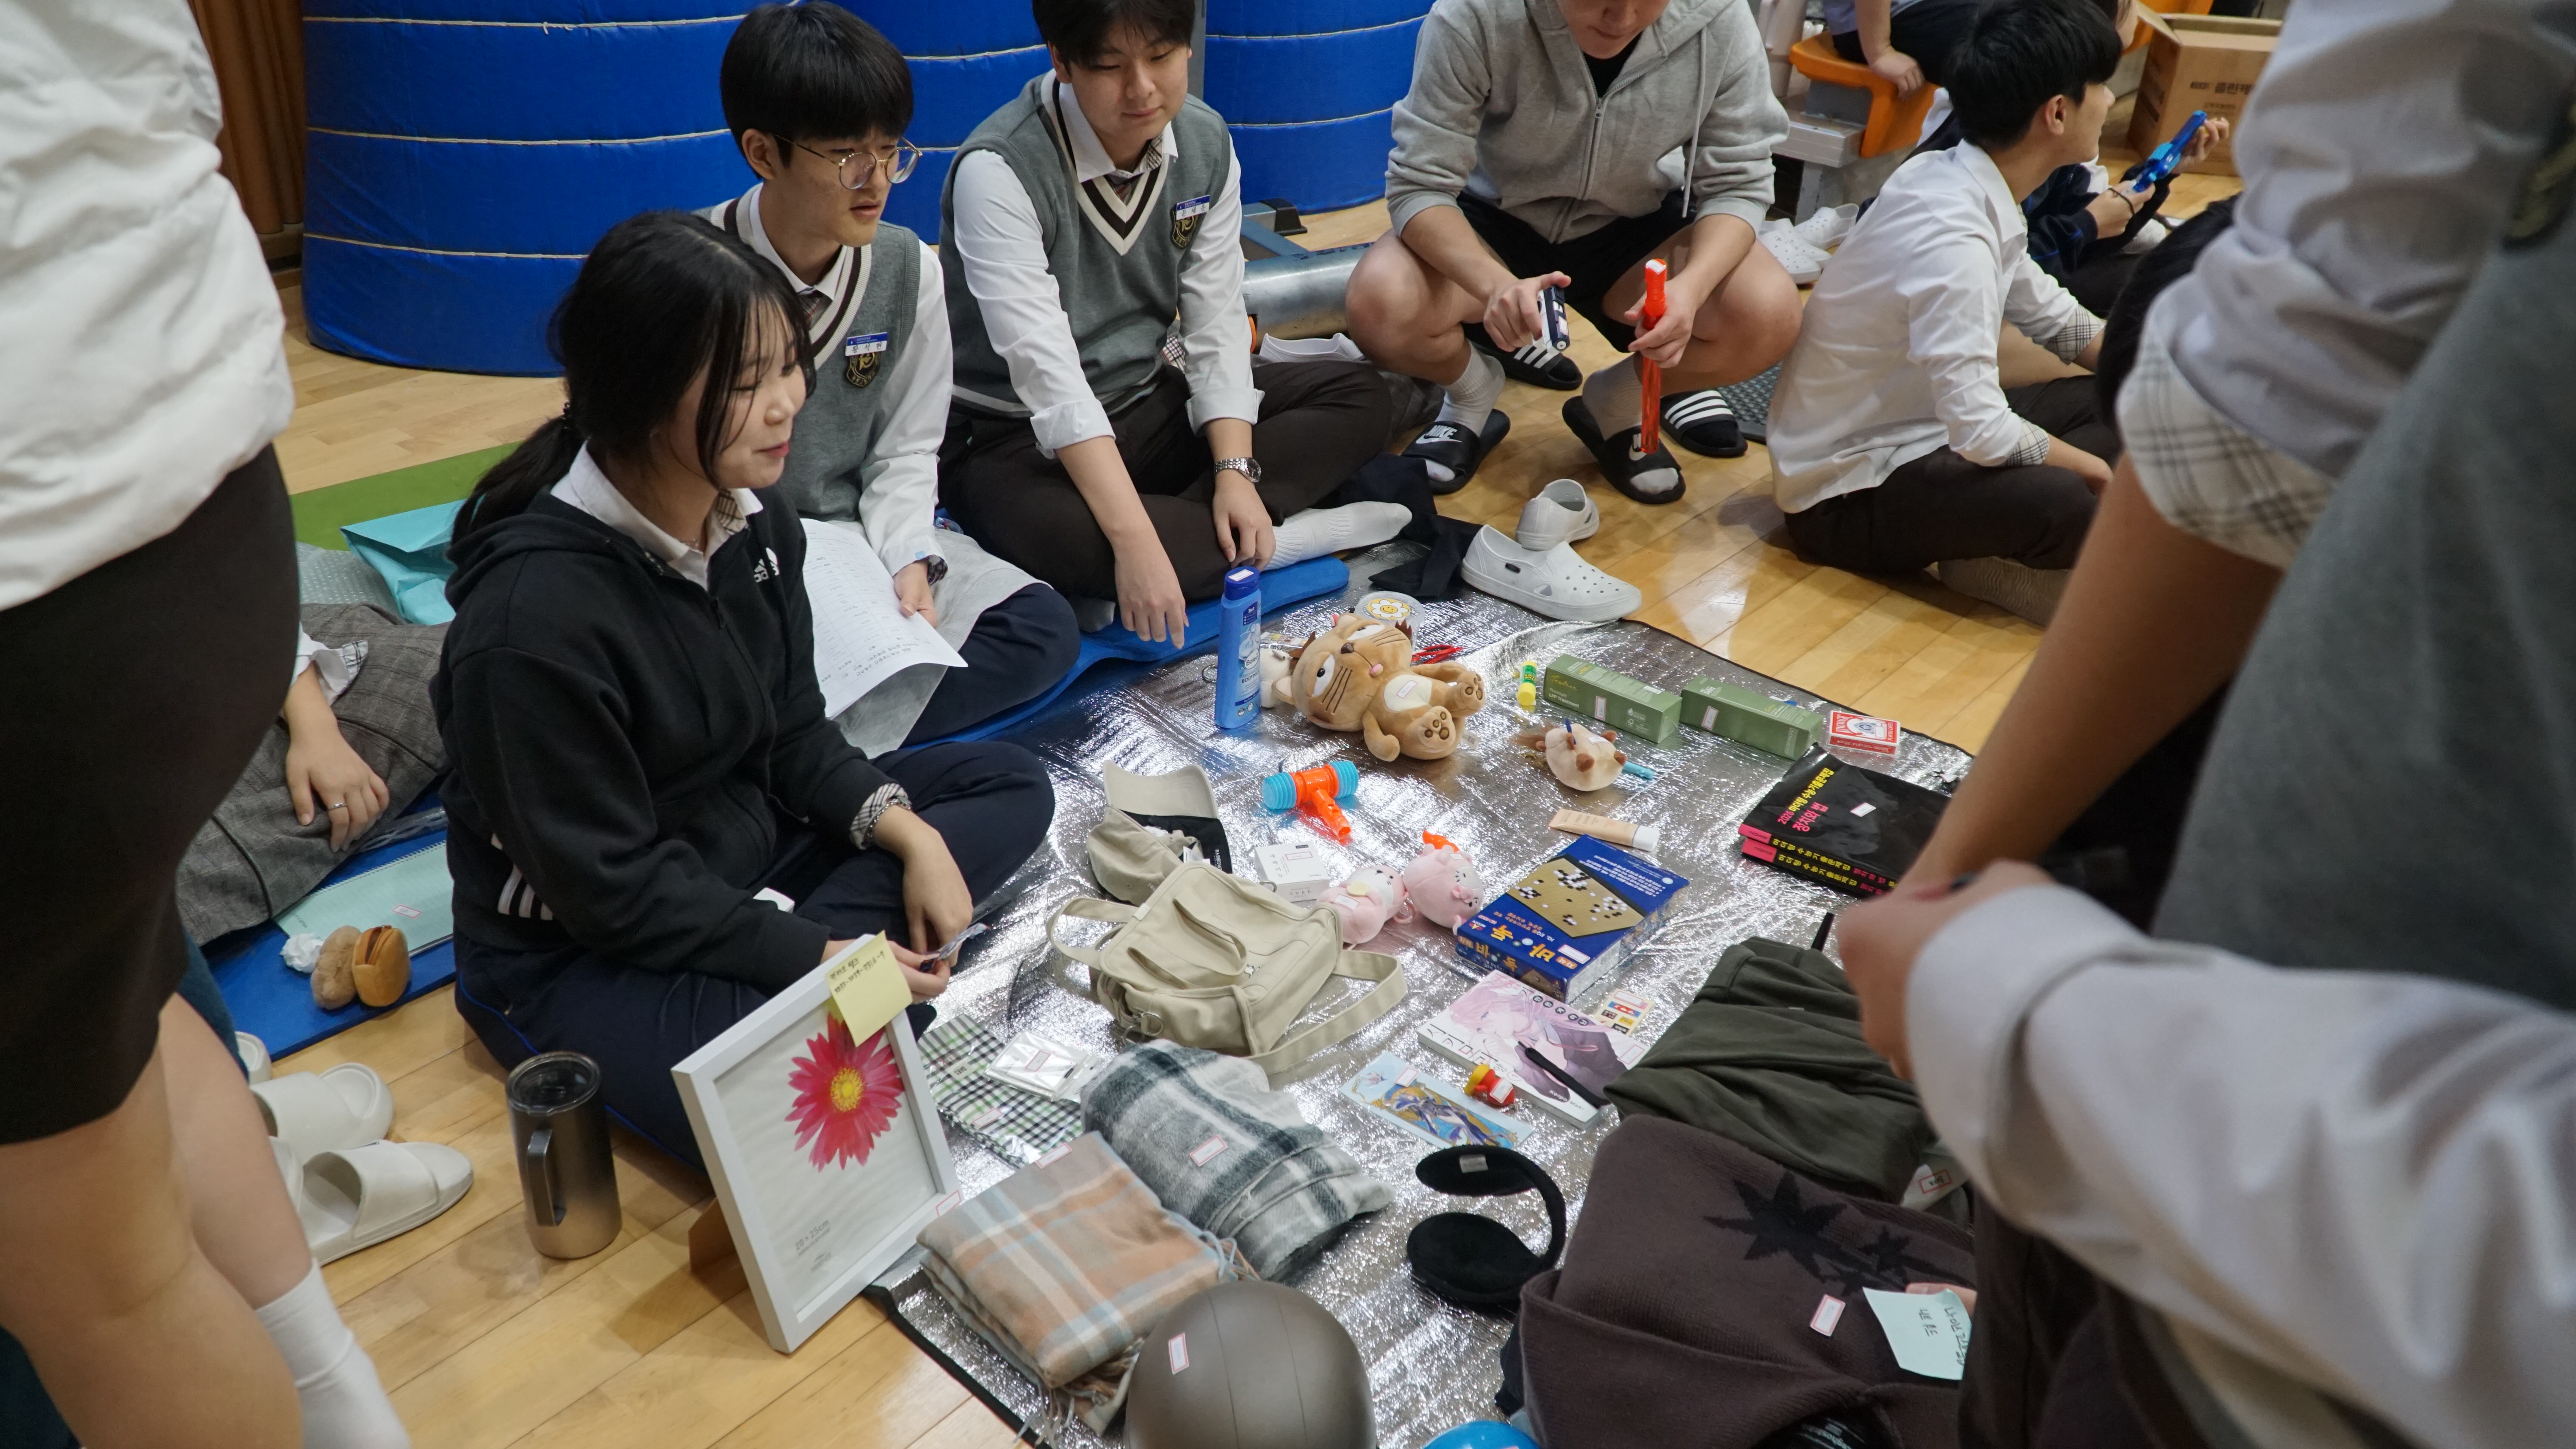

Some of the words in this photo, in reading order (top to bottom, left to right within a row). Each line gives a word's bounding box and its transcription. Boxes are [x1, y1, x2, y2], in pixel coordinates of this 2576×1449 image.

[1428, 425, 1458, 438] NIKE
[1246, 655, 1258, 666] Balea
[1558, 696, 1579, 708] Treatment
[1778, 809, 1794, 825] 2026
[1789, 797, 1810, 812] 마더텅
[1802, 767, 1834, 798] 수능기출문제집
[1792, 808, 1820, 832] 정치와
[1811, 802, 1829, 812] 법
[1772, 838, 1795, 851] 마더텅
[1797, 847, 1851, 871] 수능기출문제집
[1778, 854, 1801, 866] 마더텅
[1804, 864, 1857, 886] 수능기출문제집
[1558, 958, 1575, 968] 자석
[1549, 1090, 1567, 1102] Keigo
[1570, 1101, 1585, 1111] Maki
[810, 1221, 829, 1239] 25cm
